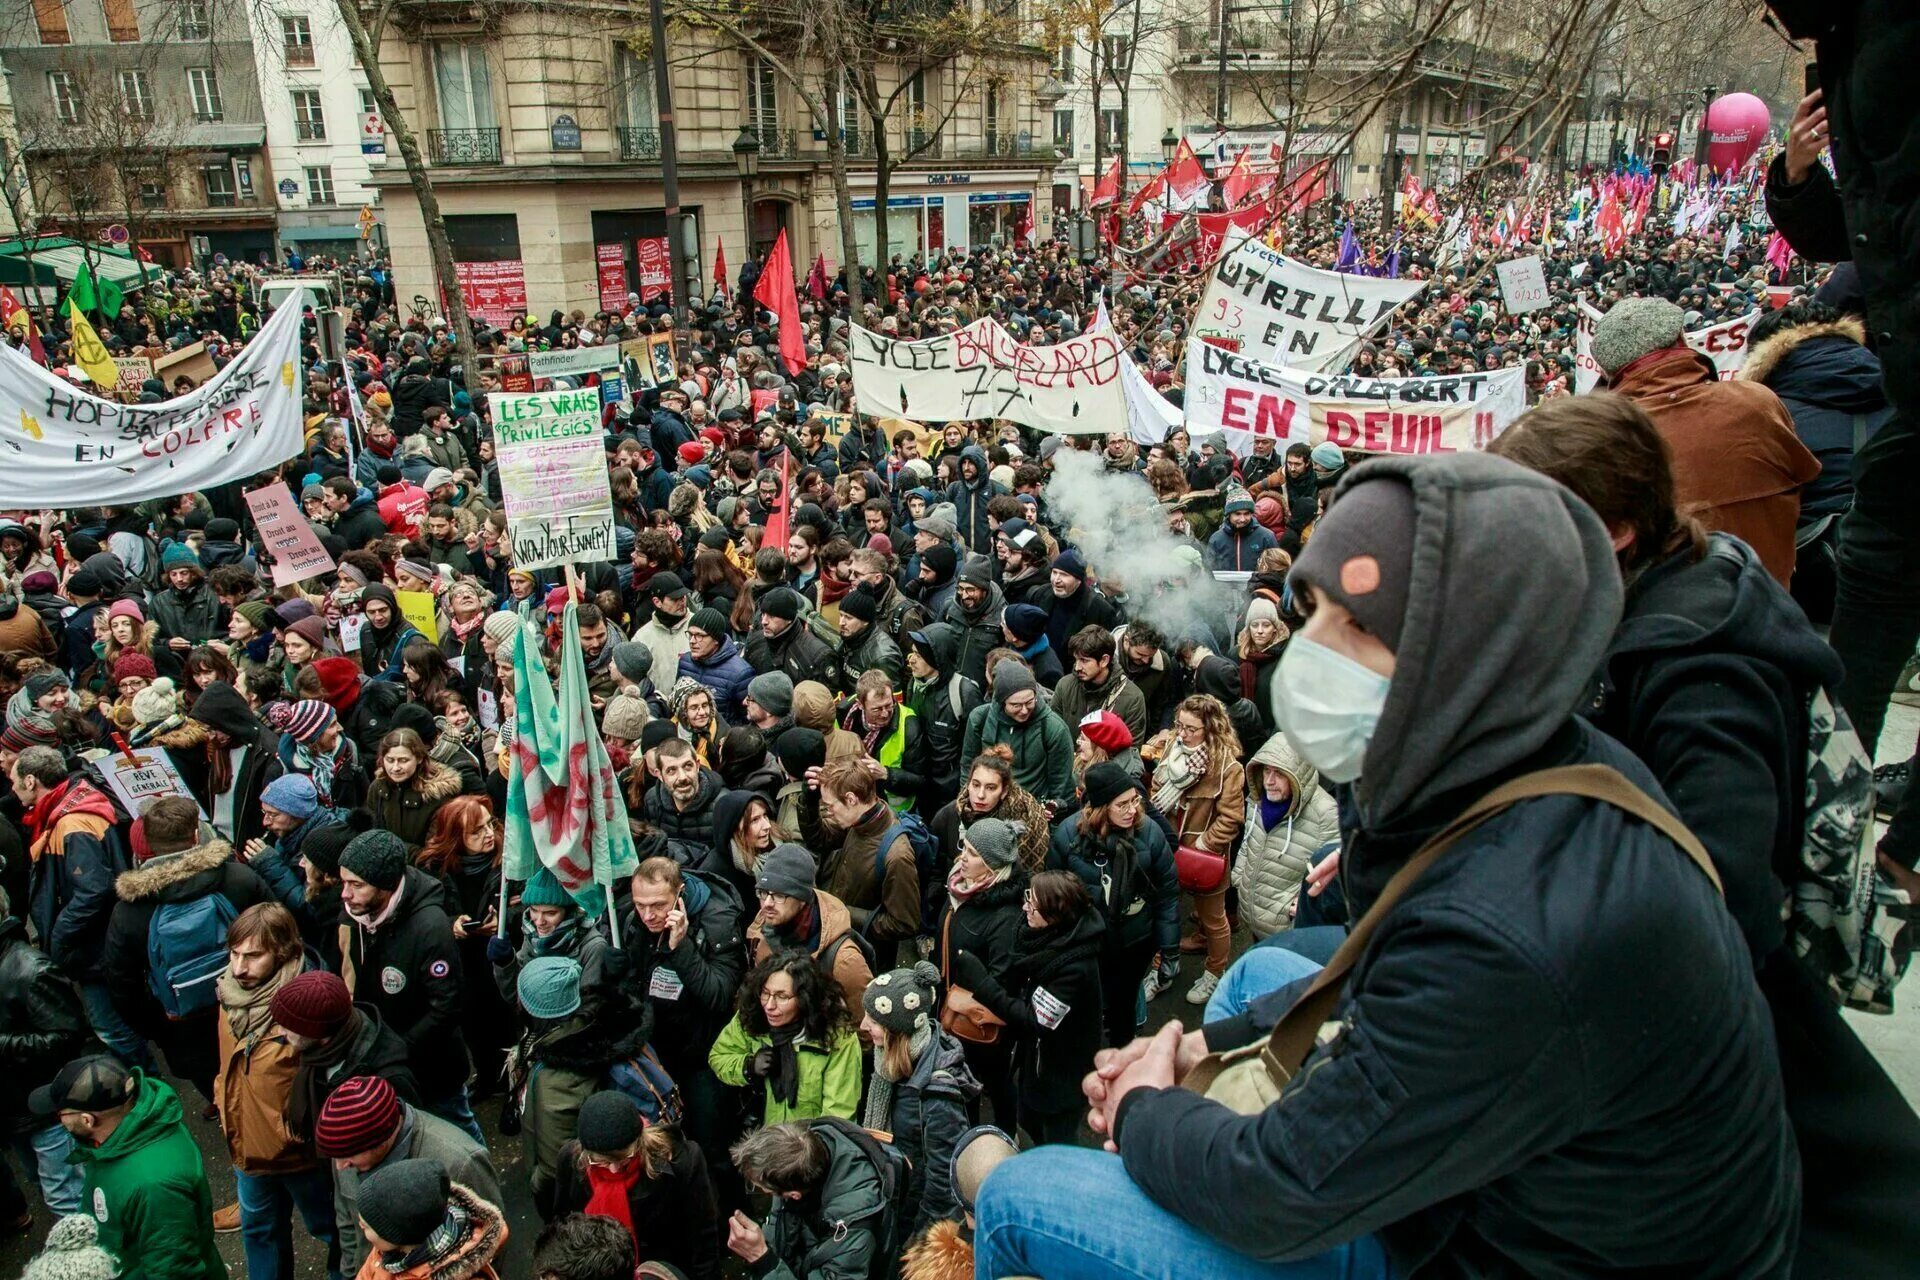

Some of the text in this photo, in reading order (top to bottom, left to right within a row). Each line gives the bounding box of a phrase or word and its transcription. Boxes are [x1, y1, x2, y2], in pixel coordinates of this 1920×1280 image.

[1710, 132, 1748, 143] lidaires
[1752, 211, 1773, 225] CA
[1217, 255, 1399, 326] UTRILL
[1213, 297, 1243, 328] 93
[1262, 321, 1319, 355] EN
[1706, 323, 1748, 353] ES
[531, 354, 575, 367] Pathfinder
[1577, 354, 1601, 373] COL
[501, 397, 543, 422] LES
[1221, 387, 1296, 439] EN
[1326, 412, 1457, 455] DEUIL
[75, 444, 114, 462] EN
[251, 502, 266, 512] Droit
[266, 524, 297, 538] Droit au
[276, 535, 299, 547] repos
[288, 545, 321, 560] Droit au
[292, 555, 327, 571] bonheur
[133, 769, 158, 781] RÊVE
[131, 780, 169, 794] GÉNÉRALE
